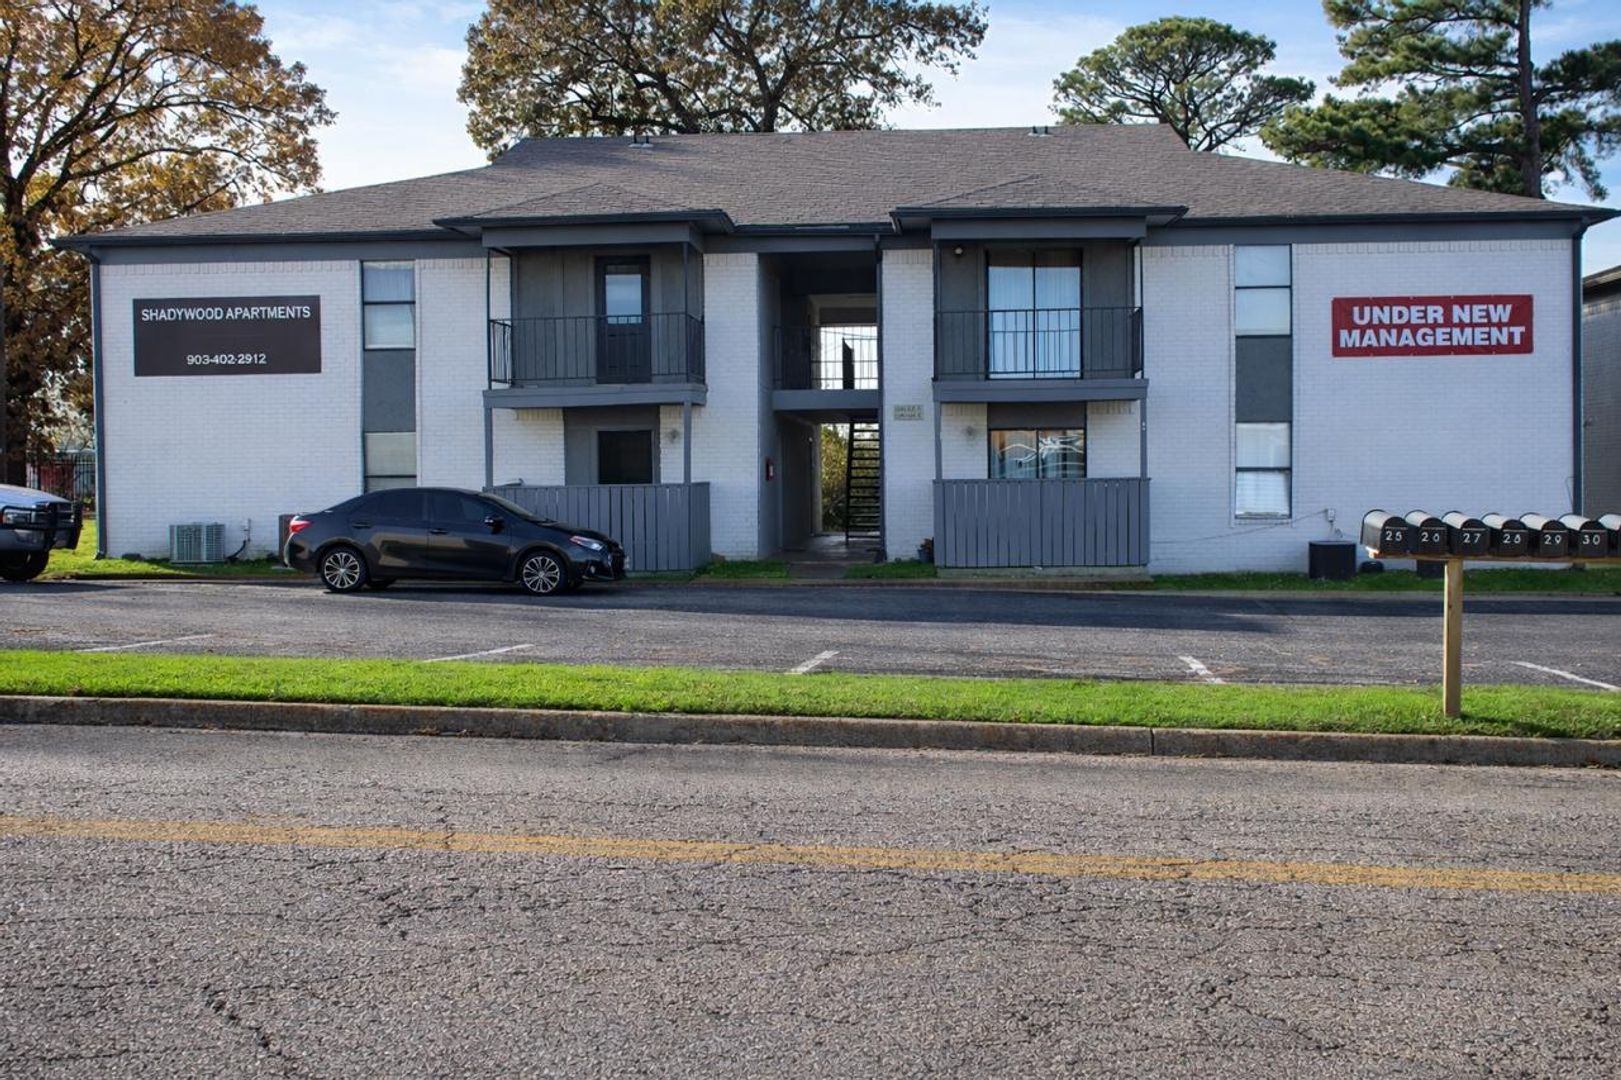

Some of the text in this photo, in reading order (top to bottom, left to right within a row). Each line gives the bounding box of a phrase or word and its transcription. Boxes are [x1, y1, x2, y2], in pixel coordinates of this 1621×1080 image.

[141, 306, 311, 321] SHADYWOOD APARTMENTS
[1352, 304, 1512, 325] UNDER NEW
[1339, 326, 1525, 348] MANAGEMENT
[187, 353, 267, 365] 903-402-2912
[1463, 532, 1481, 543] 27
[1544, 534, 1562, 545] 29
[1582, 534, 1600, 545] 30
